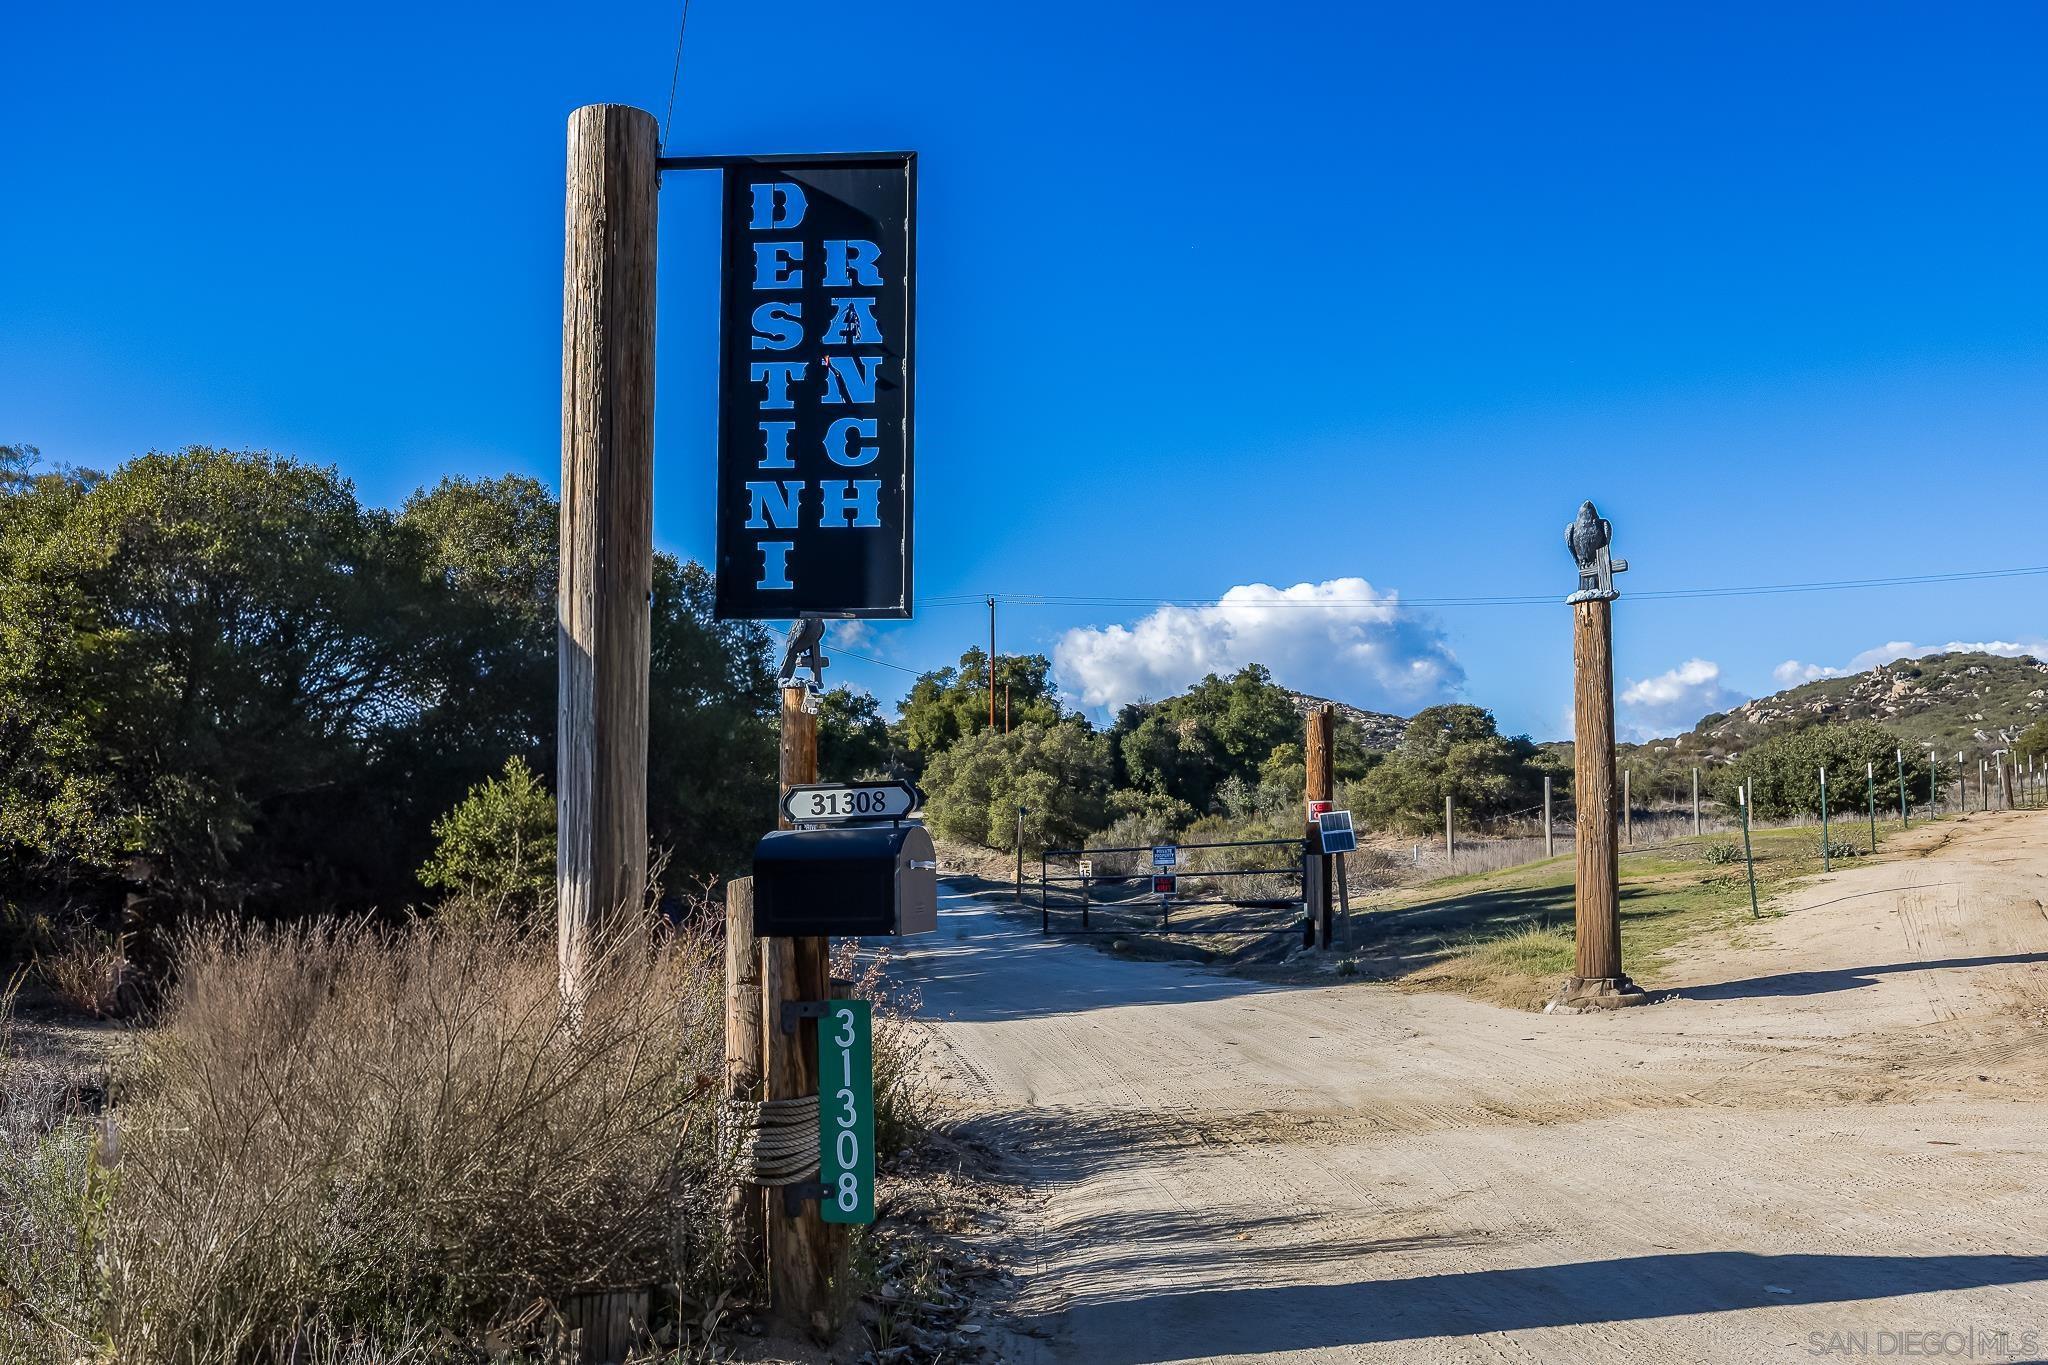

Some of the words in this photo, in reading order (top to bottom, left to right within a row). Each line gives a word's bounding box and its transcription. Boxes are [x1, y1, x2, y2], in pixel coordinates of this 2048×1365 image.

[744, 182, 809, 590] DESTINI
[819, 239, 884, 528] RANCH
[810, 790, 886, 816] 31308
[1081, 869, 1090, 877] 15
[834, 1008, 859, 1212] 31308
